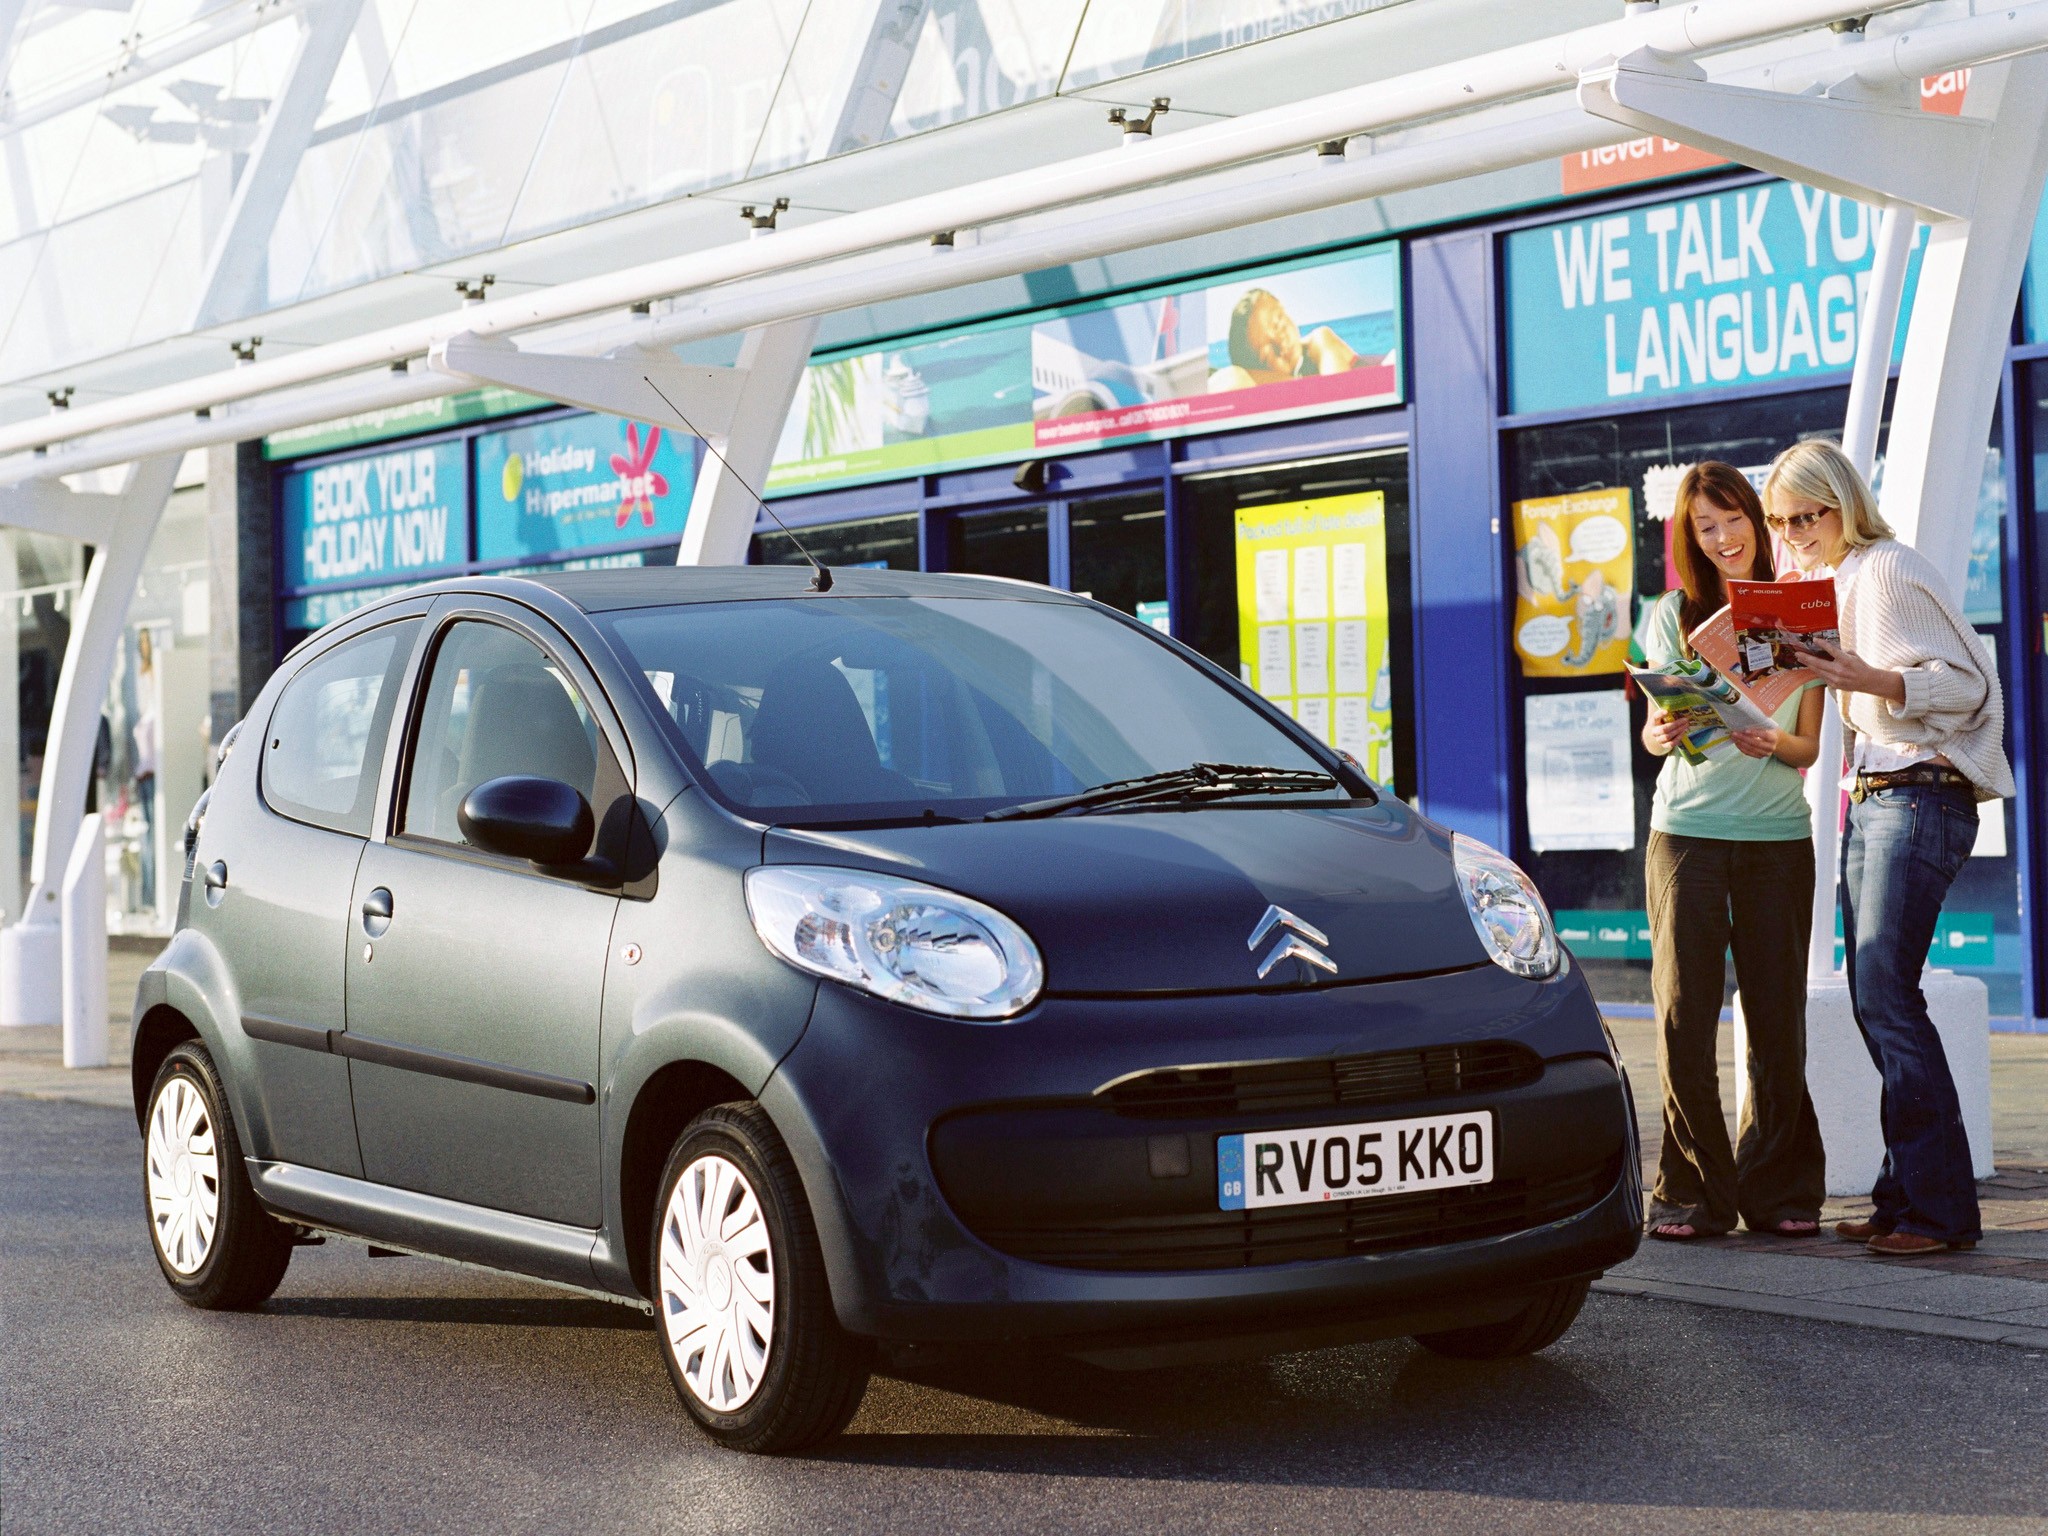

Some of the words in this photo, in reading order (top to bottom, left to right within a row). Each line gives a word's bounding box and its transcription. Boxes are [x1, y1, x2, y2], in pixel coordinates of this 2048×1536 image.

[1553, 215, 1632, 309] WE
[1646, 188, 1774, 293] TALK
[525, 444, 595, 477] Holiday
[313, 460, 371, 522] BOOK
[375, 449, 436, 512] YOUR
[525, 470, 656, 517] Hypermarket
[1562, 497, 1618, 515] Exchange
[305, 515, 388, 579] HOLIDAY
[393, 505, 448, 569] NOW
[1800, 599, 1831, 610] cuba
[1254, 1132, 1383, 1197] RV05
[1398, 1122, 1483, 1182] KKO
[1224, 1180, 1242, 1197] GB
